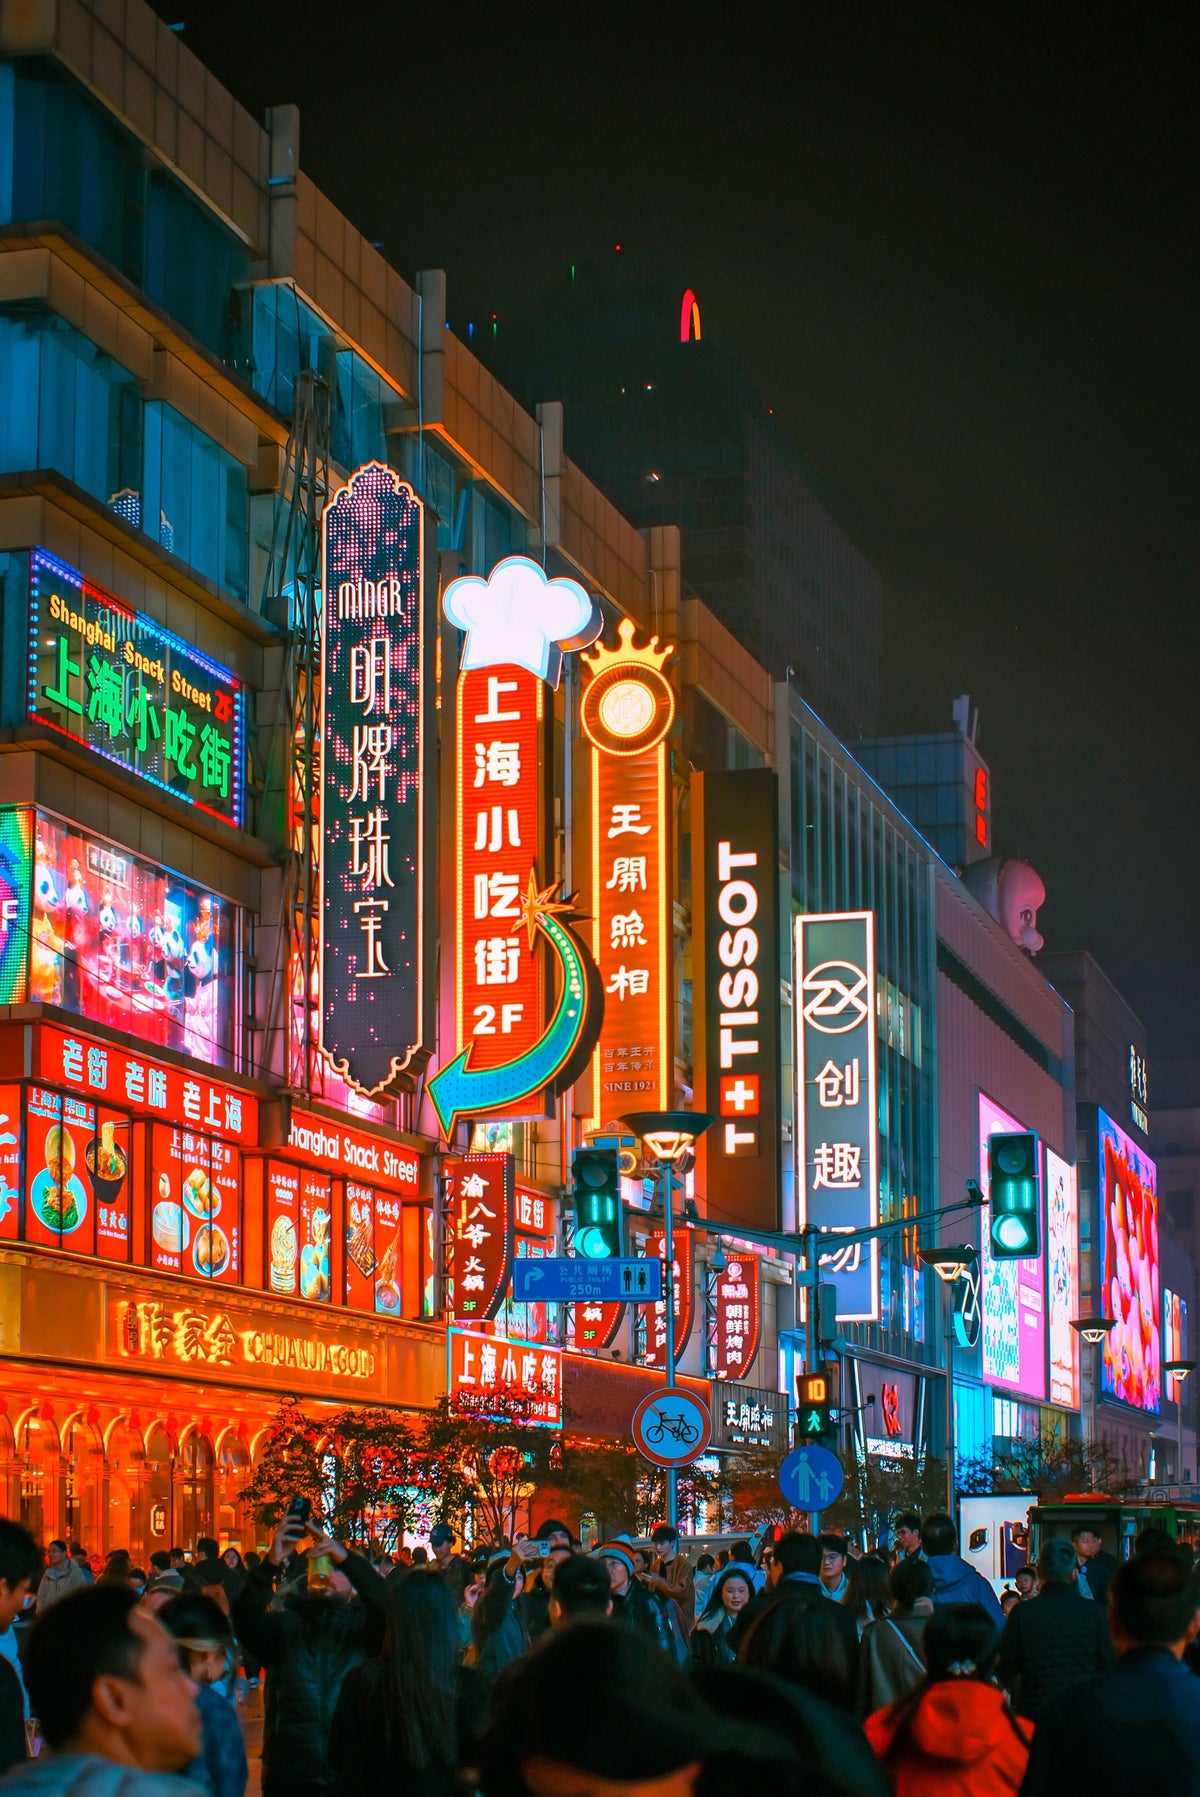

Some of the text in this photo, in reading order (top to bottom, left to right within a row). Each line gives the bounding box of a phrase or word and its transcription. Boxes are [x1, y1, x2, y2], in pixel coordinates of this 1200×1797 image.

[49, 594, 116, 653] Shanghai
[124, 641, 165, 683] Snack
[171, 669, 212, 713] Street
[42, 636, 231, 798] 上海小吃街
[346, 637, 395, 978] 明牌珠宝
[474, 677, 521, 985] 上海小吃街
[606, 804, 651, 1001] 王開照相
[718, 840, 759, 1068] TISSOT
[472, 1003, 523, 1035] 2F
[63, 1039, 242, 1133] 老街 老味 老上海
[170, 1129, 224, 1161] 上海小吃
[288, 1118, 418, 1184] hanghai Snack Street
[725, 1123, 755, 1154] T
[560, 1264, 612, 1276] 公共厕所
[570, 1284, 601, 1295] 250m
[463, 1301, 476, 1311] 3F
[582, 1301, 602, 1322] 锅
[583, 1331, 595, 1339] 3F
[725, 1304, 743, 1365] 朝鲜烤肉
[458, 1340, 557, 1398] 上海小吃街
[808, 1380, 825, 1401] 10
